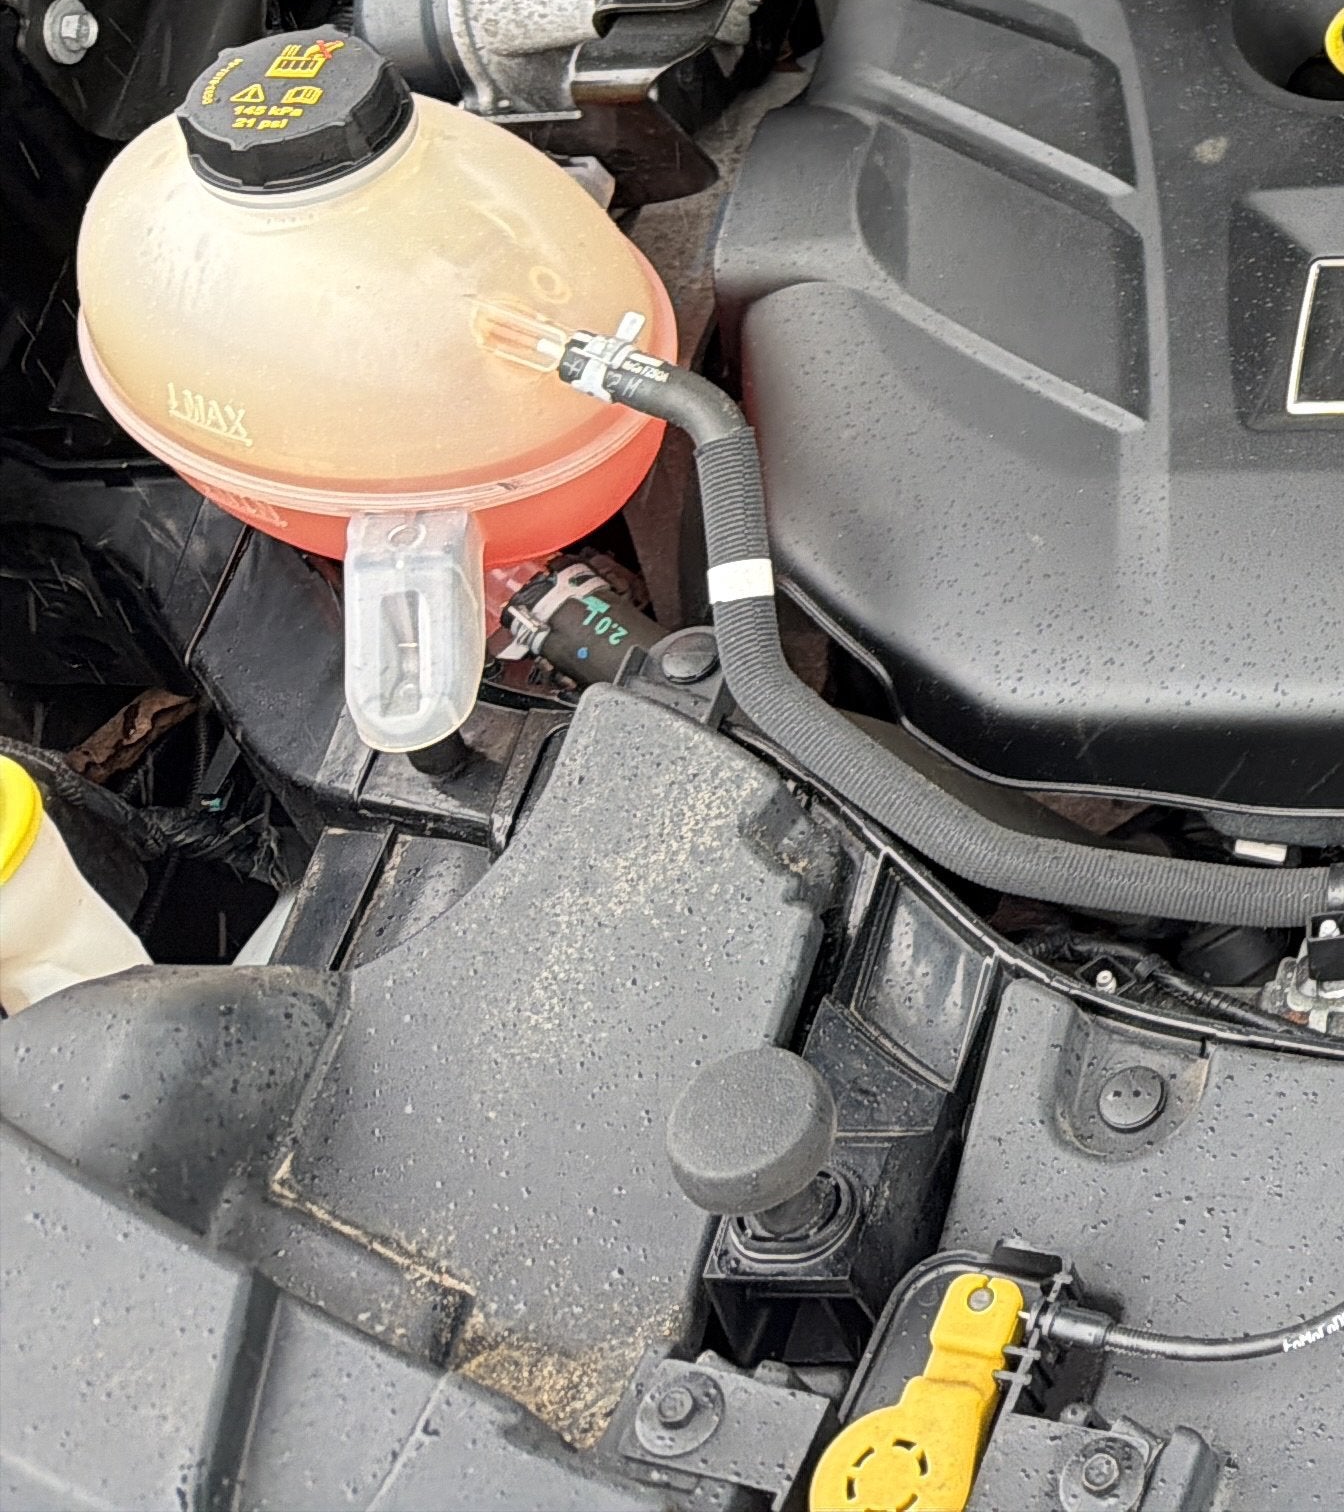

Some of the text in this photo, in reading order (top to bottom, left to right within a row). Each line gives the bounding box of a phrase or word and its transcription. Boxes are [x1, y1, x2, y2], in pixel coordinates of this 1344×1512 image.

[233, 105, 304, 117] 145 kPa
[231, 117, 289, 131] 21 psi
